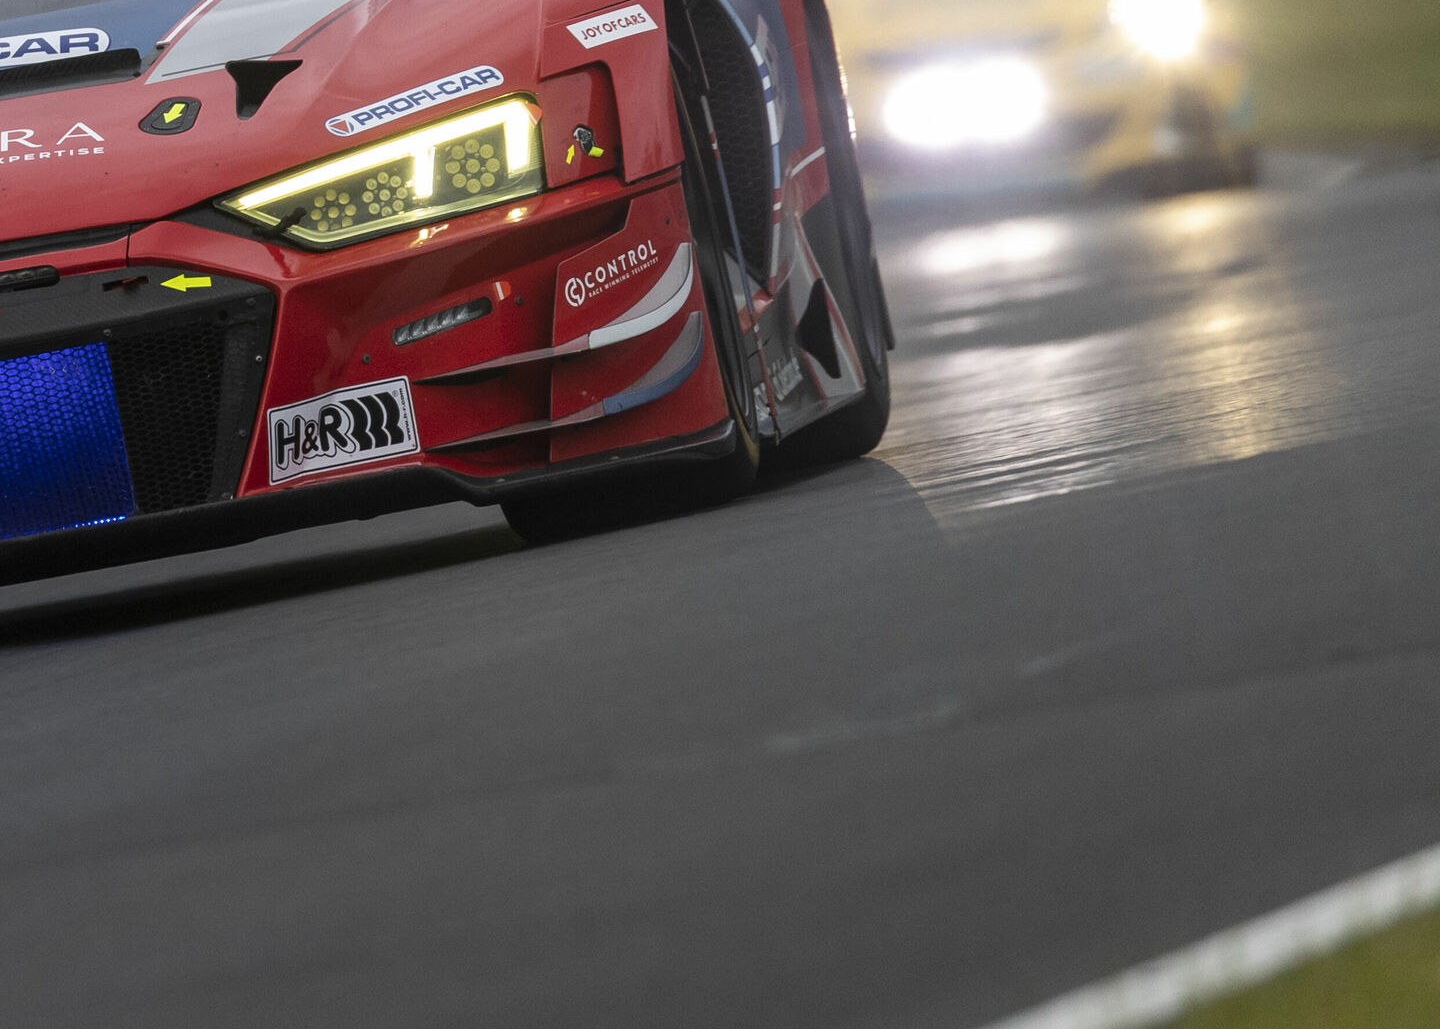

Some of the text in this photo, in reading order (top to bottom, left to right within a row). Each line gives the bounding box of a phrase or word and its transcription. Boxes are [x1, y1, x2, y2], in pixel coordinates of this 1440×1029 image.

[581, 13, 646, 40] JOY OF CARS
[351, 68, 501, 125] PROFI-CAR
[584, 240, 657, 288] CONTROL
[276, 405, 352, 467] H&R
